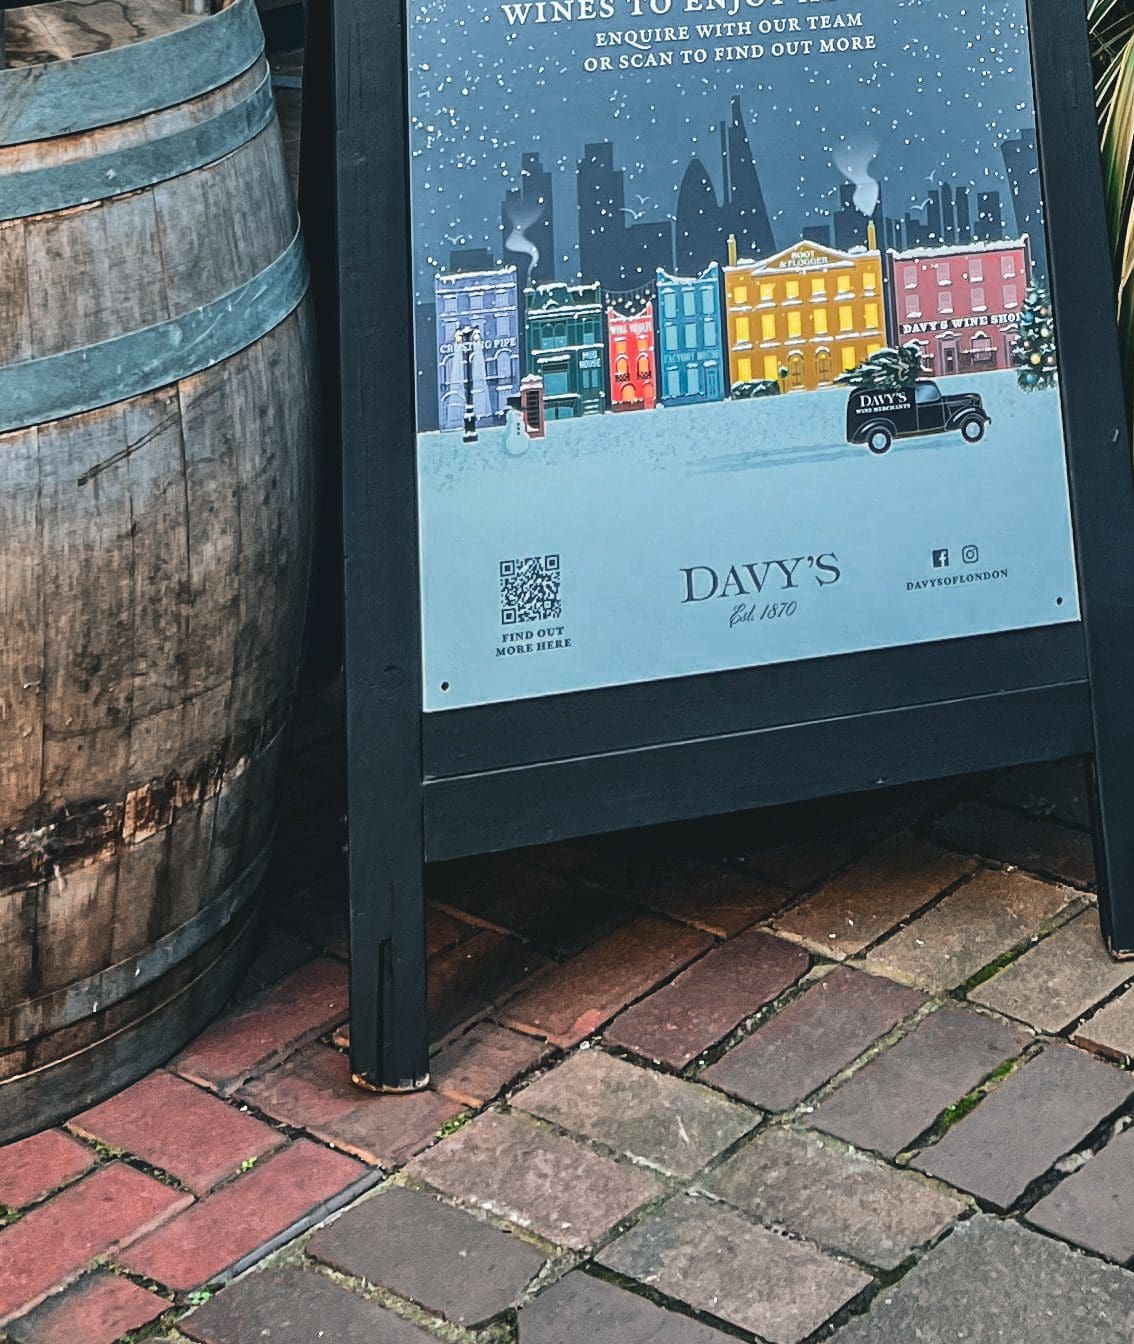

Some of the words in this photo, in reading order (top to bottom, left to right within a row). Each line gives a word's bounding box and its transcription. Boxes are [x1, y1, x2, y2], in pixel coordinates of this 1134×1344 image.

[501, 0, 616, 26] WINES
[594, 25, 691, 50] ENQUIRE
[695, 20, 753, 39] WITH
[758, 16, 802, 34] OUR
[806, 11, 864, 30] TEAM
[583, 56, 616, 73] OR
[618, 51, 675, 70] SCAN
[679, 48, 709, 65] TO
[713, 43, 765, 62] FIND
[770, 39, 813, 57] OUT
[819, 34, 877, 53] MORE
[790, 249, 816, 260] BOOT
[902, 319, 948, 334] DAVY'S
[951, 315, 988, 330] WINE
[494, 337, 517, 349] PIPE
[860, 392, 907, 407] DAVY'S
[873, 403, 910, 412] MERCHANTS
[679, 552, 841, 603] DAVY'S
[905, 568, 1009, 591] DAVYSOFLONDON
[760, 601, 797, 621] 1870
[502, 630, 534, 643] FIND
[536, 626, 565, 638] OUT
[495, 644, 534, 657] MORE
[536, 638, 572, 652] HERE
